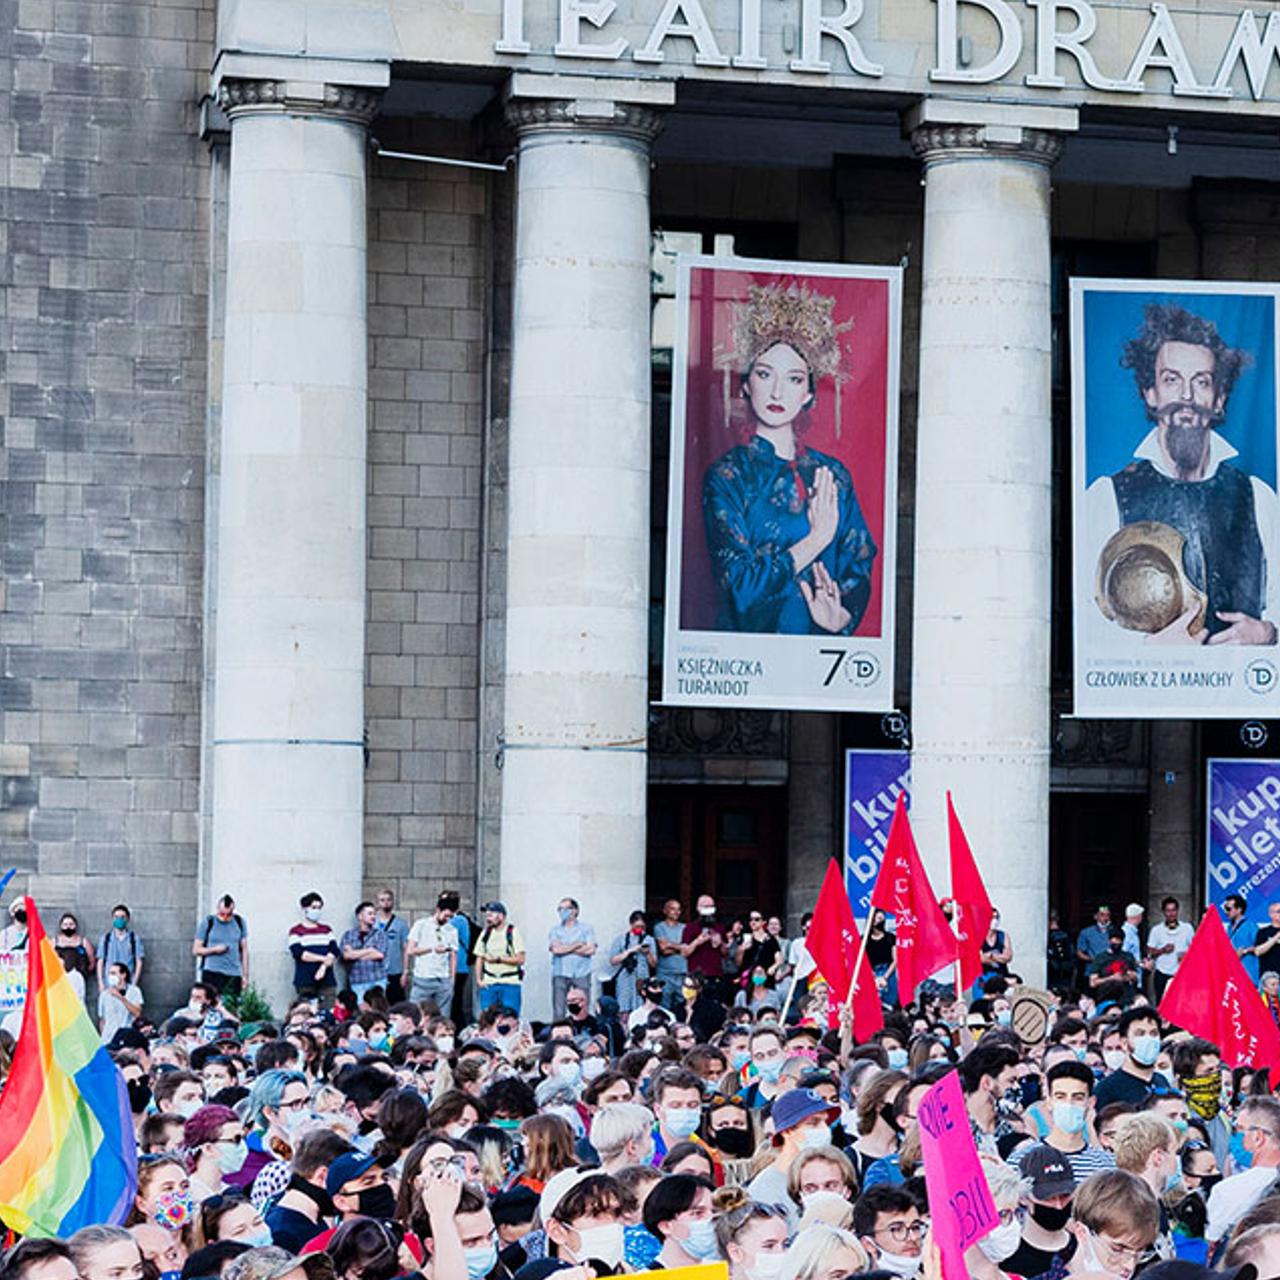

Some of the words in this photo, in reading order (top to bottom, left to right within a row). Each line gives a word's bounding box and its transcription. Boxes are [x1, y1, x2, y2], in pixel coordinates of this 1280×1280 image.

[677, 656, 763, 678] KSIĘŻNICZKA
[677, 678, 750, 697] TURANDOT
[1086, 670, 1148, 688] CZŁOWIEK
[1151, 671, 1158, 687] Z
[1161, 672, 1176, 687] LA
[1179, 671, 1234, 688] MANCHY
